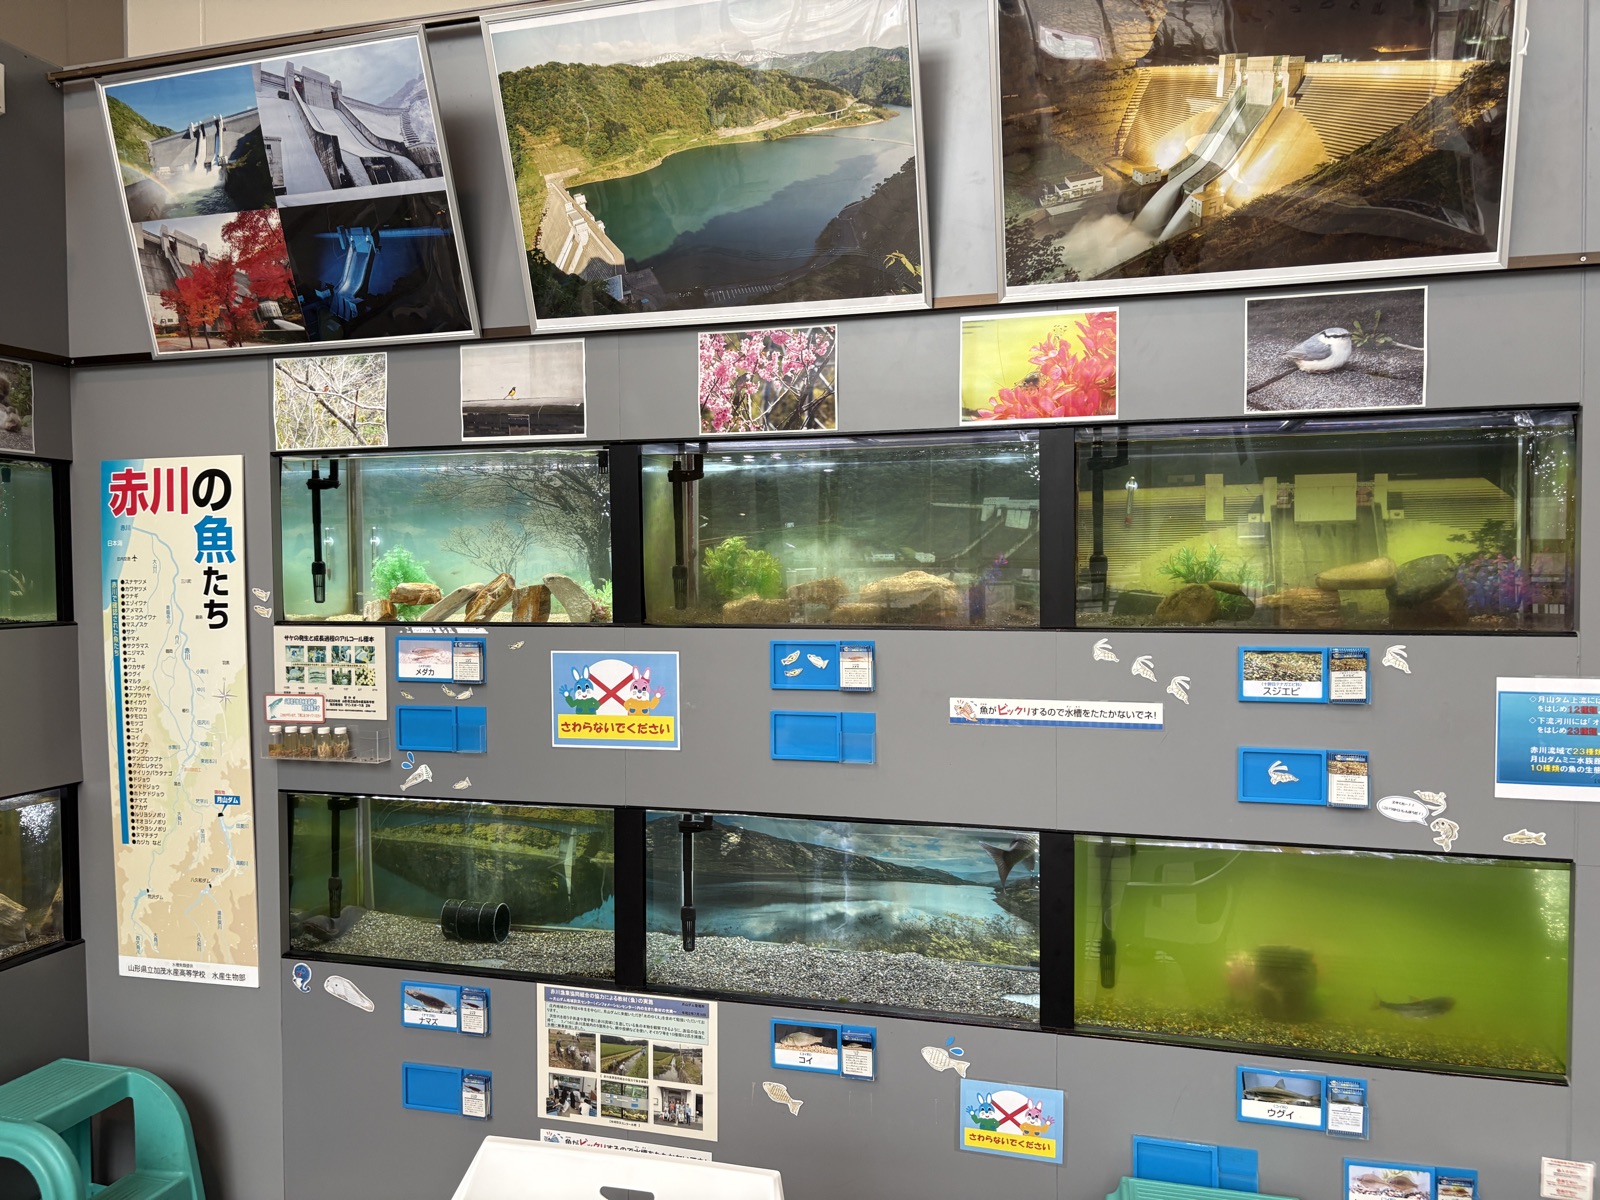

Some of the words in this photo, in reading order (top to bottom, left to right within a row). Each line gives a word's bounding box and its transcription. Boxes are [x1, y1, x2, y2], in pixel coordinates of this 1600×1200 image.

[109, 467, 232, 516] 赤川の
[194, 515, 236, 629] 魚たち
[415, 668, 435, 676] メダカ
[1263, 687, 1301, 696] スジエビ
[561, 722, 671, 735] さわらないでください
[419, 1017, 439, 1026] ナマズ
[798, 1056, 813, 1065] コイ
[1267, 1108, 1295, 1120] ウグイ
[969, 1132, 1051, 1151] さわらないでください
